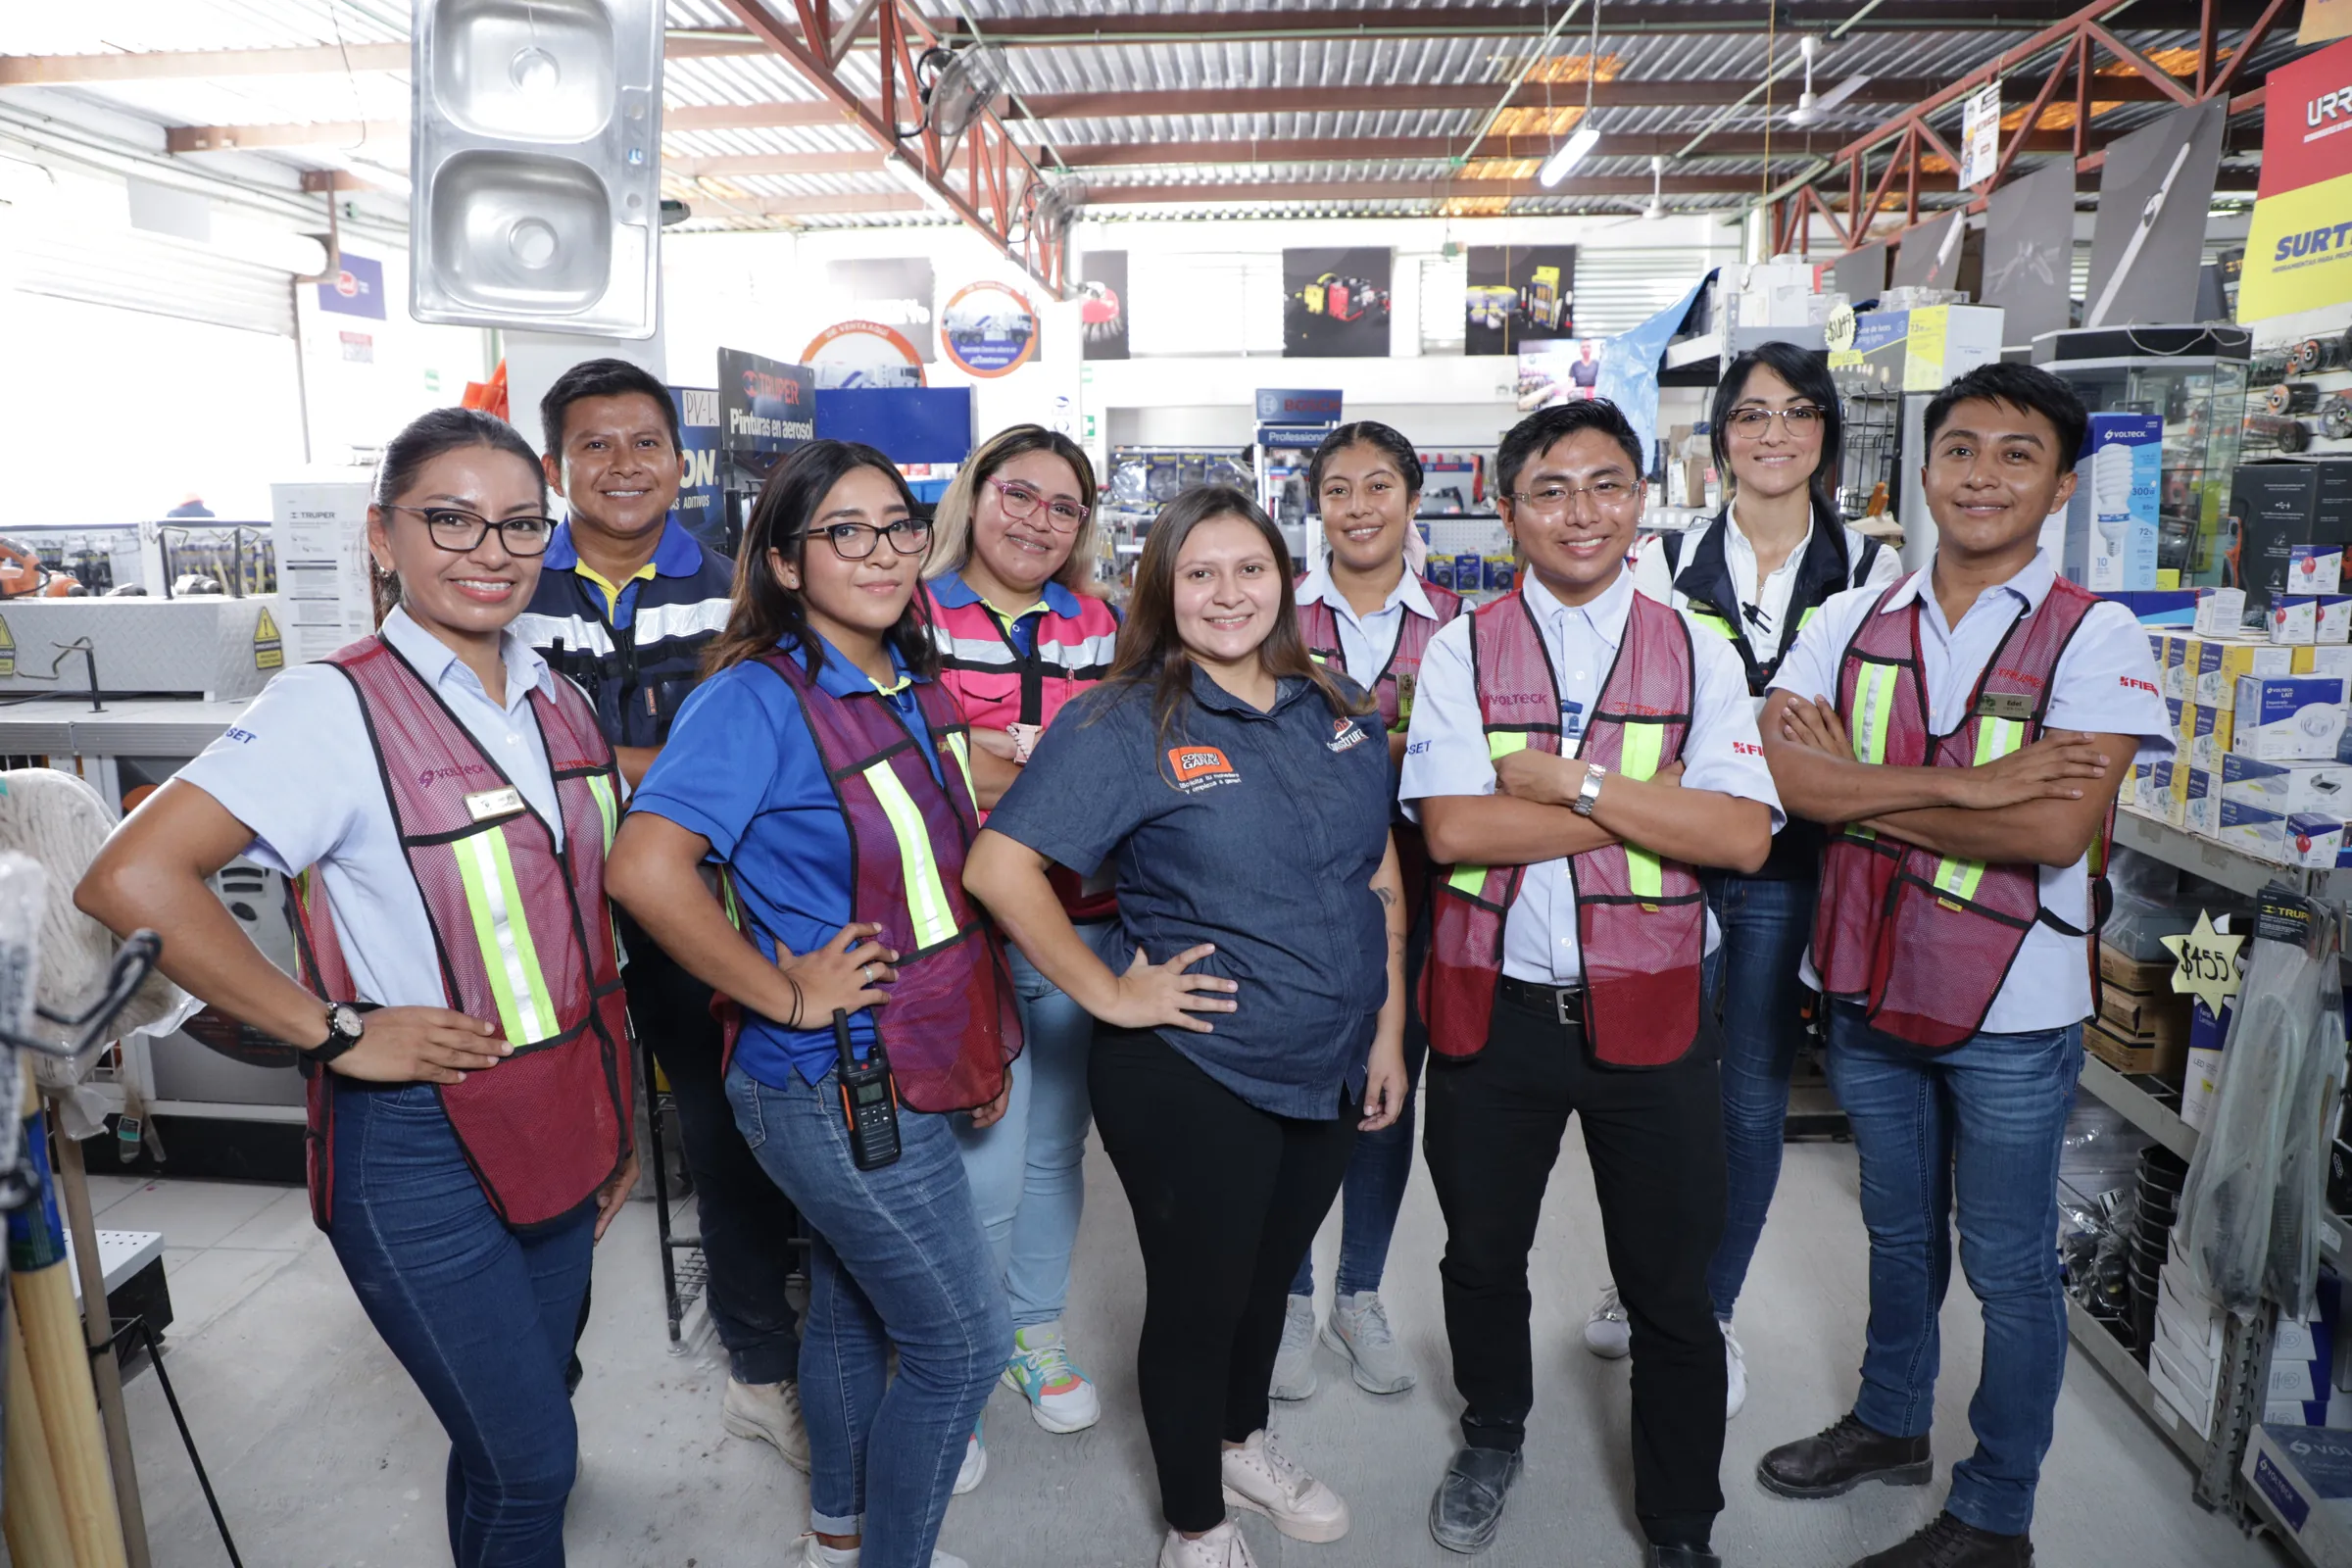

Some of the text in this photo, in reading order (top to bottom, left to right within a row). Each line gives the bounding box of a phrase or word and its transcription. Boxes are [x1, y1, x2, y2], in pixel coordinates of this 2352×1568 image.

[2275, 221, 2352, 262] SURT
[759, 372, 800, 405] TRUPER
[1284, 397, 1341, 412] BOSCH
[730, 408, 813, 440] Pinturas en aerosol
[683, 494, 710, 510] ADITIVOS
[2096, 558, 2107, 566] 10
[2130, 678, 2159, 698] FIB
[1490, 693, 1546, 706] VOLTECK
[1405, 740, 1432, 756] SET
[1181, 753, 1218, 761] CONSTRU
[1183, 759, 1220, 769] GANAS
[2180, 939, 2230, 982] $455
